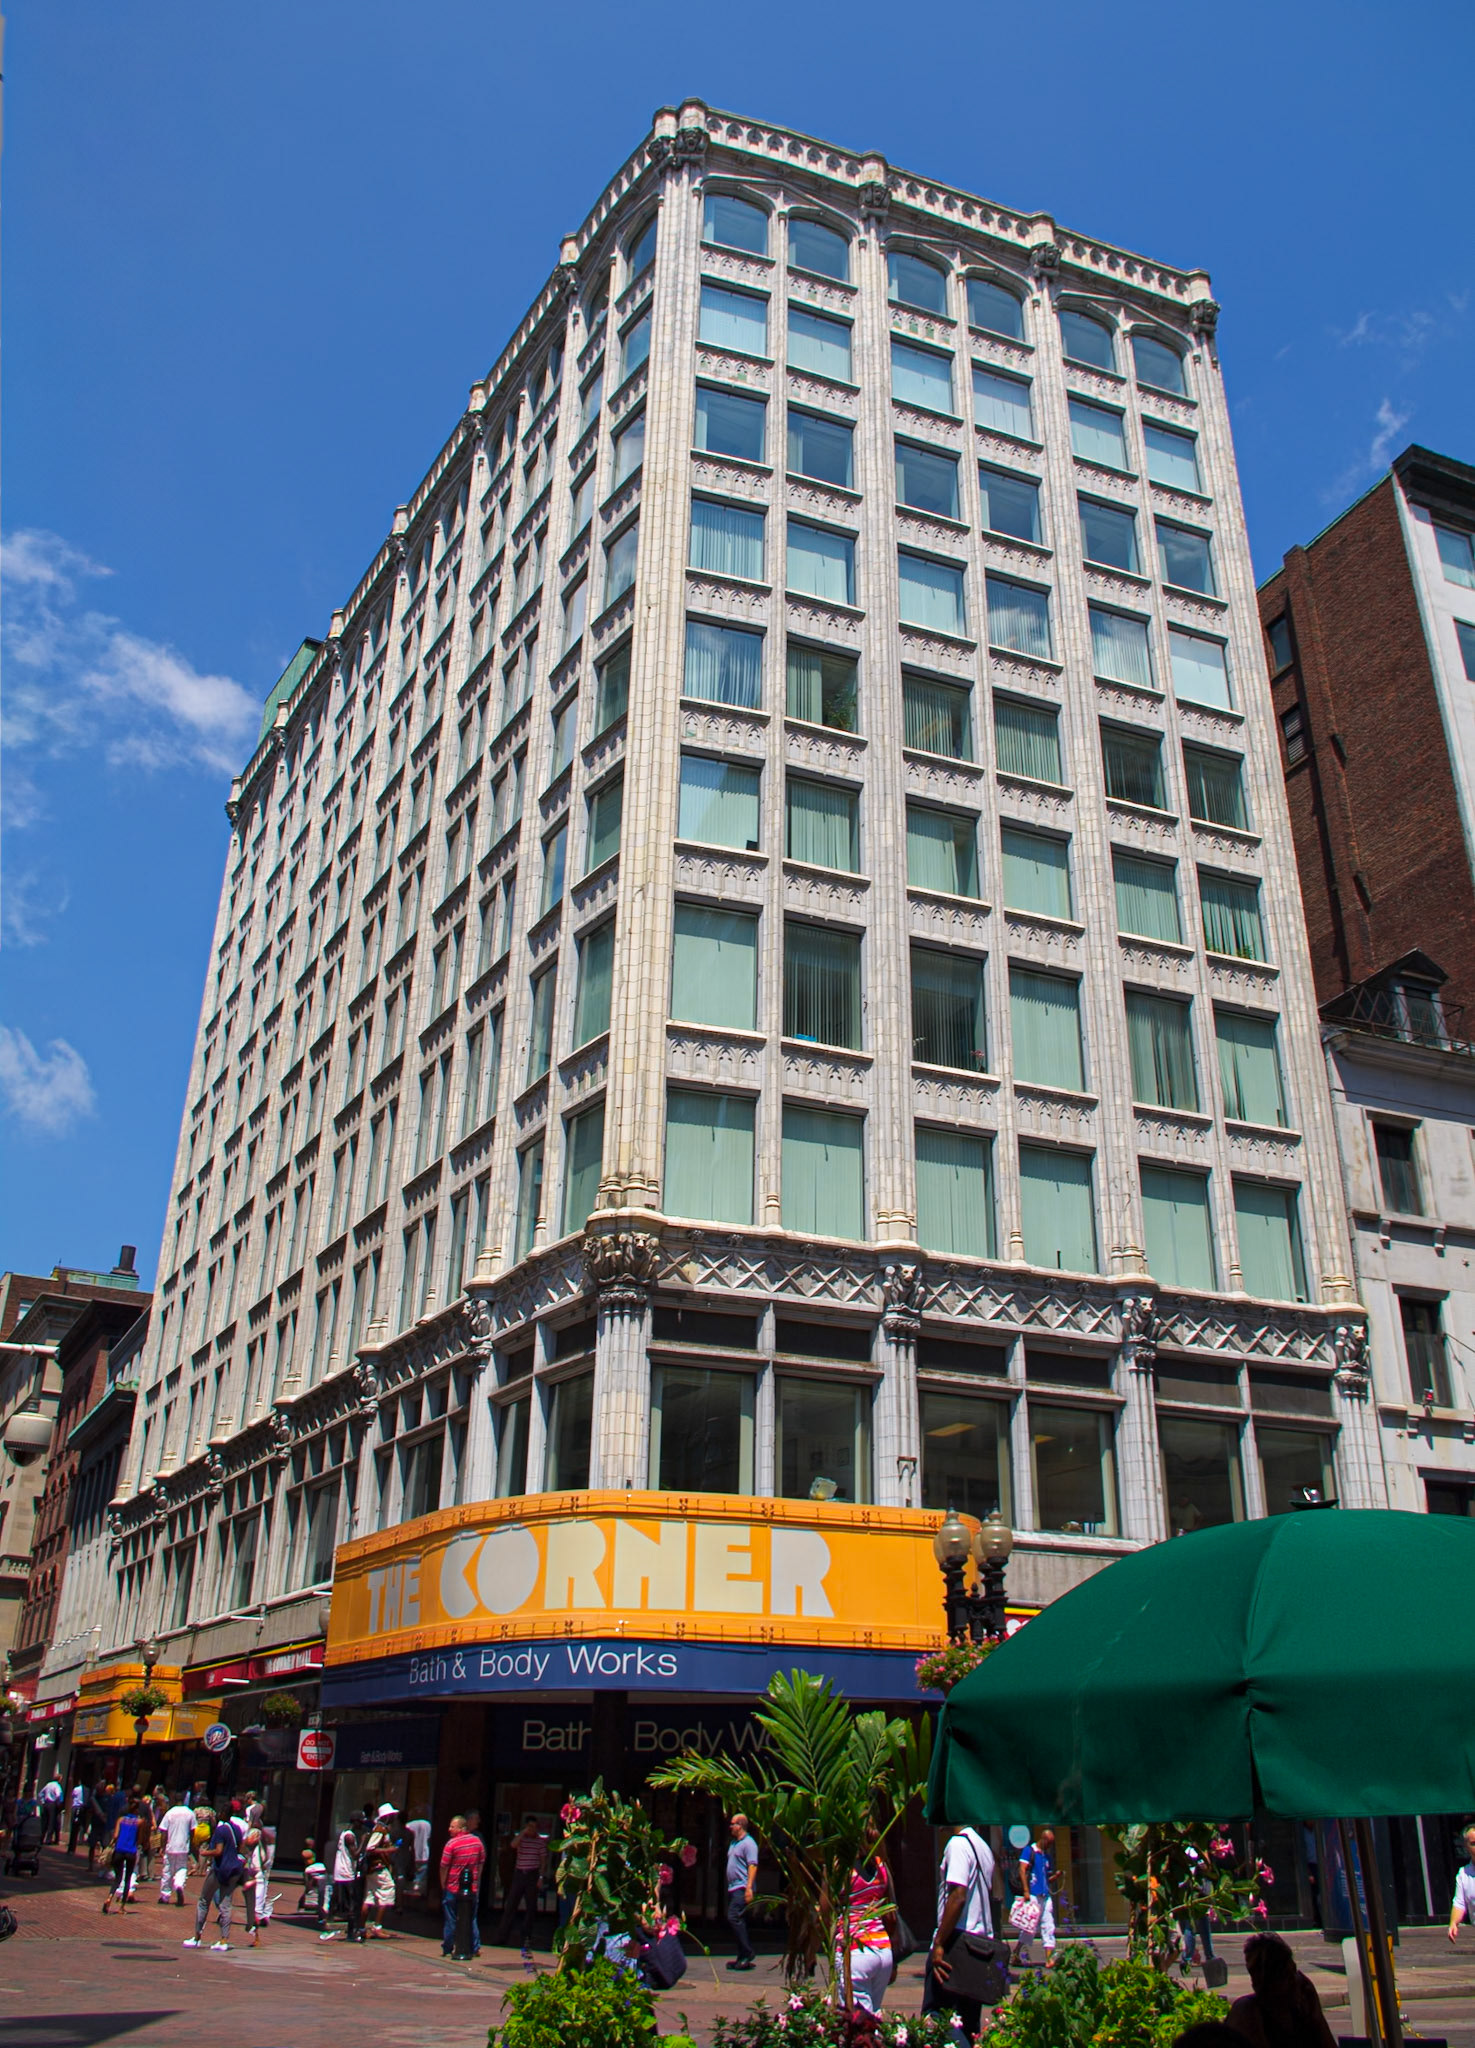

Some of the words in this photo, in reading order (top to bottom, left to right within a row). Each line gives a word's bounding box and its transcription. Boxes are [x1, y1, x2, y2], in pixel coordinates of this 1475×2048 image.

[367, 1556, 421, 1635] THE
[440, 1518, 835, 1618] CORNER
[409, 1655, 447, 1685] Bath
[452, 1651, 467, 1679] &
[479, 1648, 551, 1682] Body
[567, 1645, 678, 1677] Works
[304, 1739, 316, 1747] DO
[317, 1739, 330, 1747] NOT
[306, 1753, 327, 1761] ENTER
[634, 1720, 724, 1758] Body
